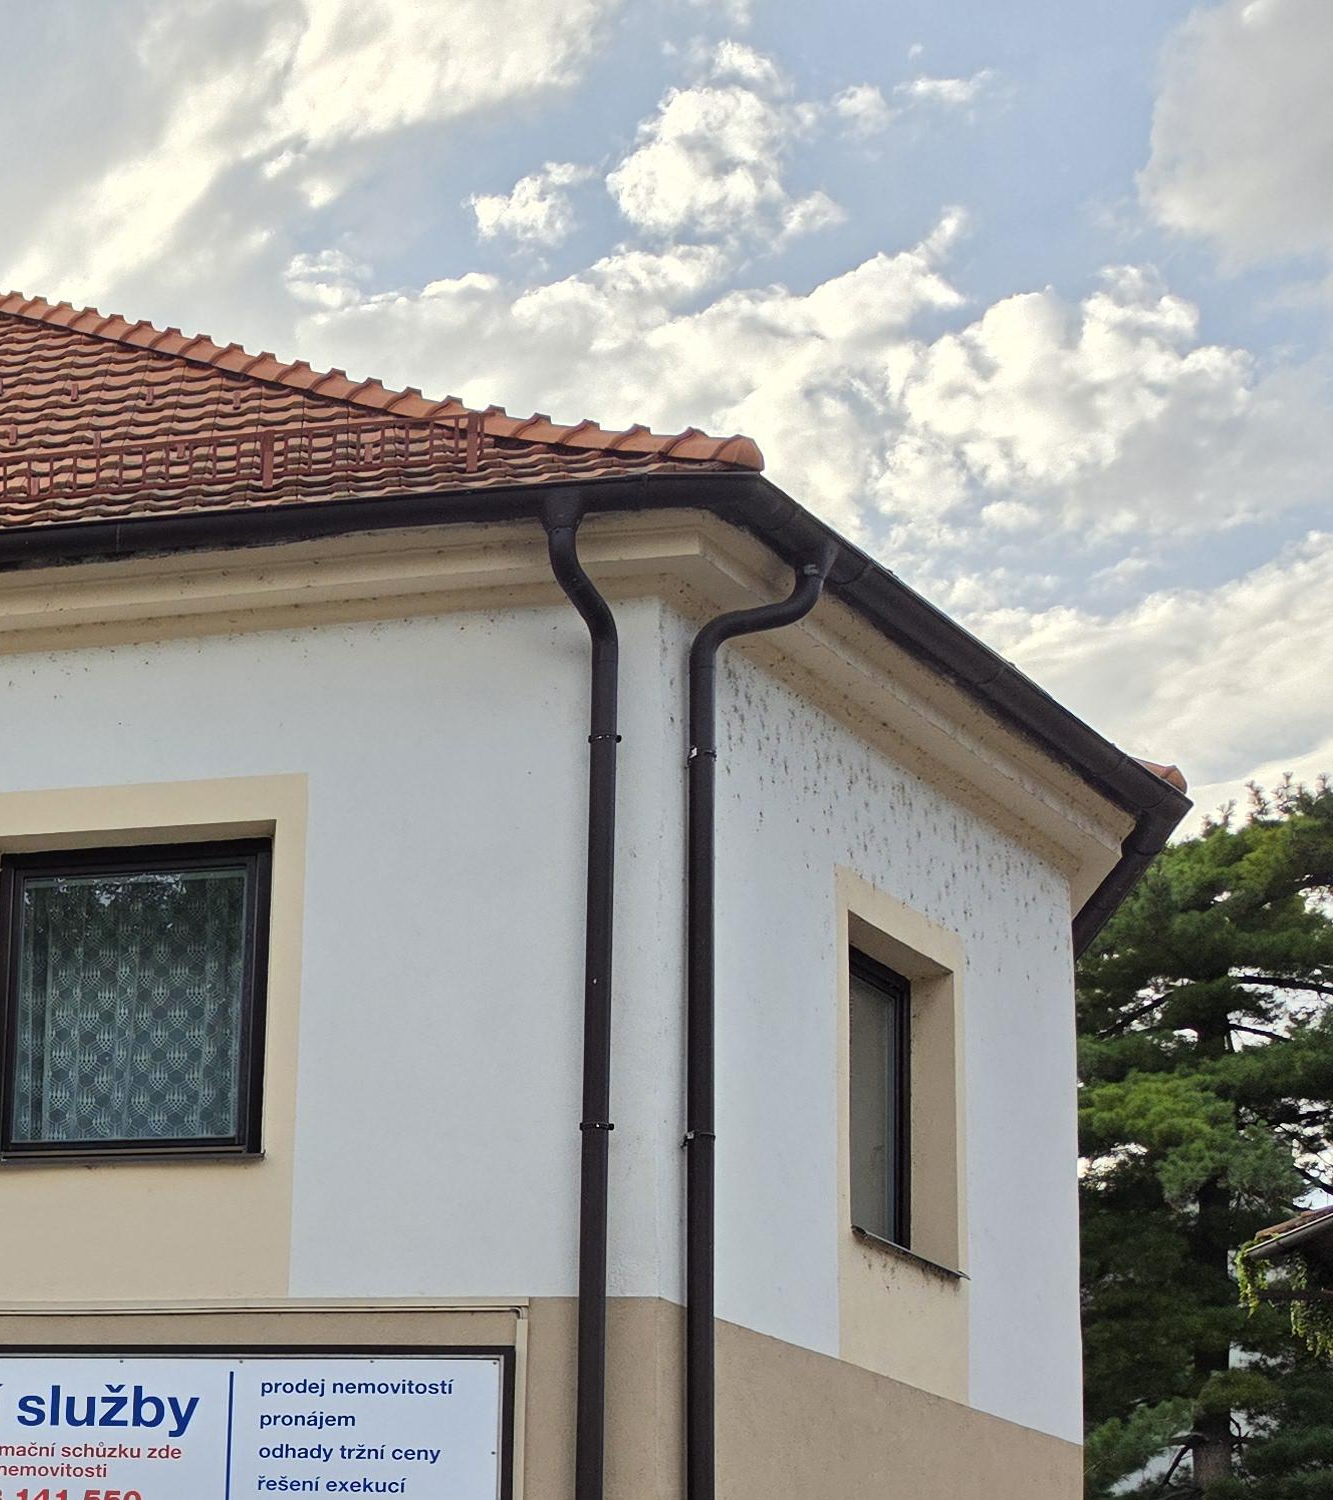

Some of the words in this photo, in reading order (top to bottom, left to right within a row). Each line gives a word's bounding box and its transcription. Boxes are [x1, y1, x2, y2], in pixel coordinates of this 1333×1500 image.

[261, 1379, 325, 1397] prodej
[333, 1380, 454, 1394] nemovitostí
[17, 1384, 200, 1437] služby
[260, 1412, 356, 1429] pronájem
[61, 1442, 141, 1458] schůzku
[148, 1445, 182, 1459] zde
[259, 1444, 333, 1462] odhady
[340, 1445, 386, 1460] tržní
[392, 1448, 441, 1464] ceny
[258, 1476, 320, 1491] řešení
[326, 1477, 407, 1493] exekucí
